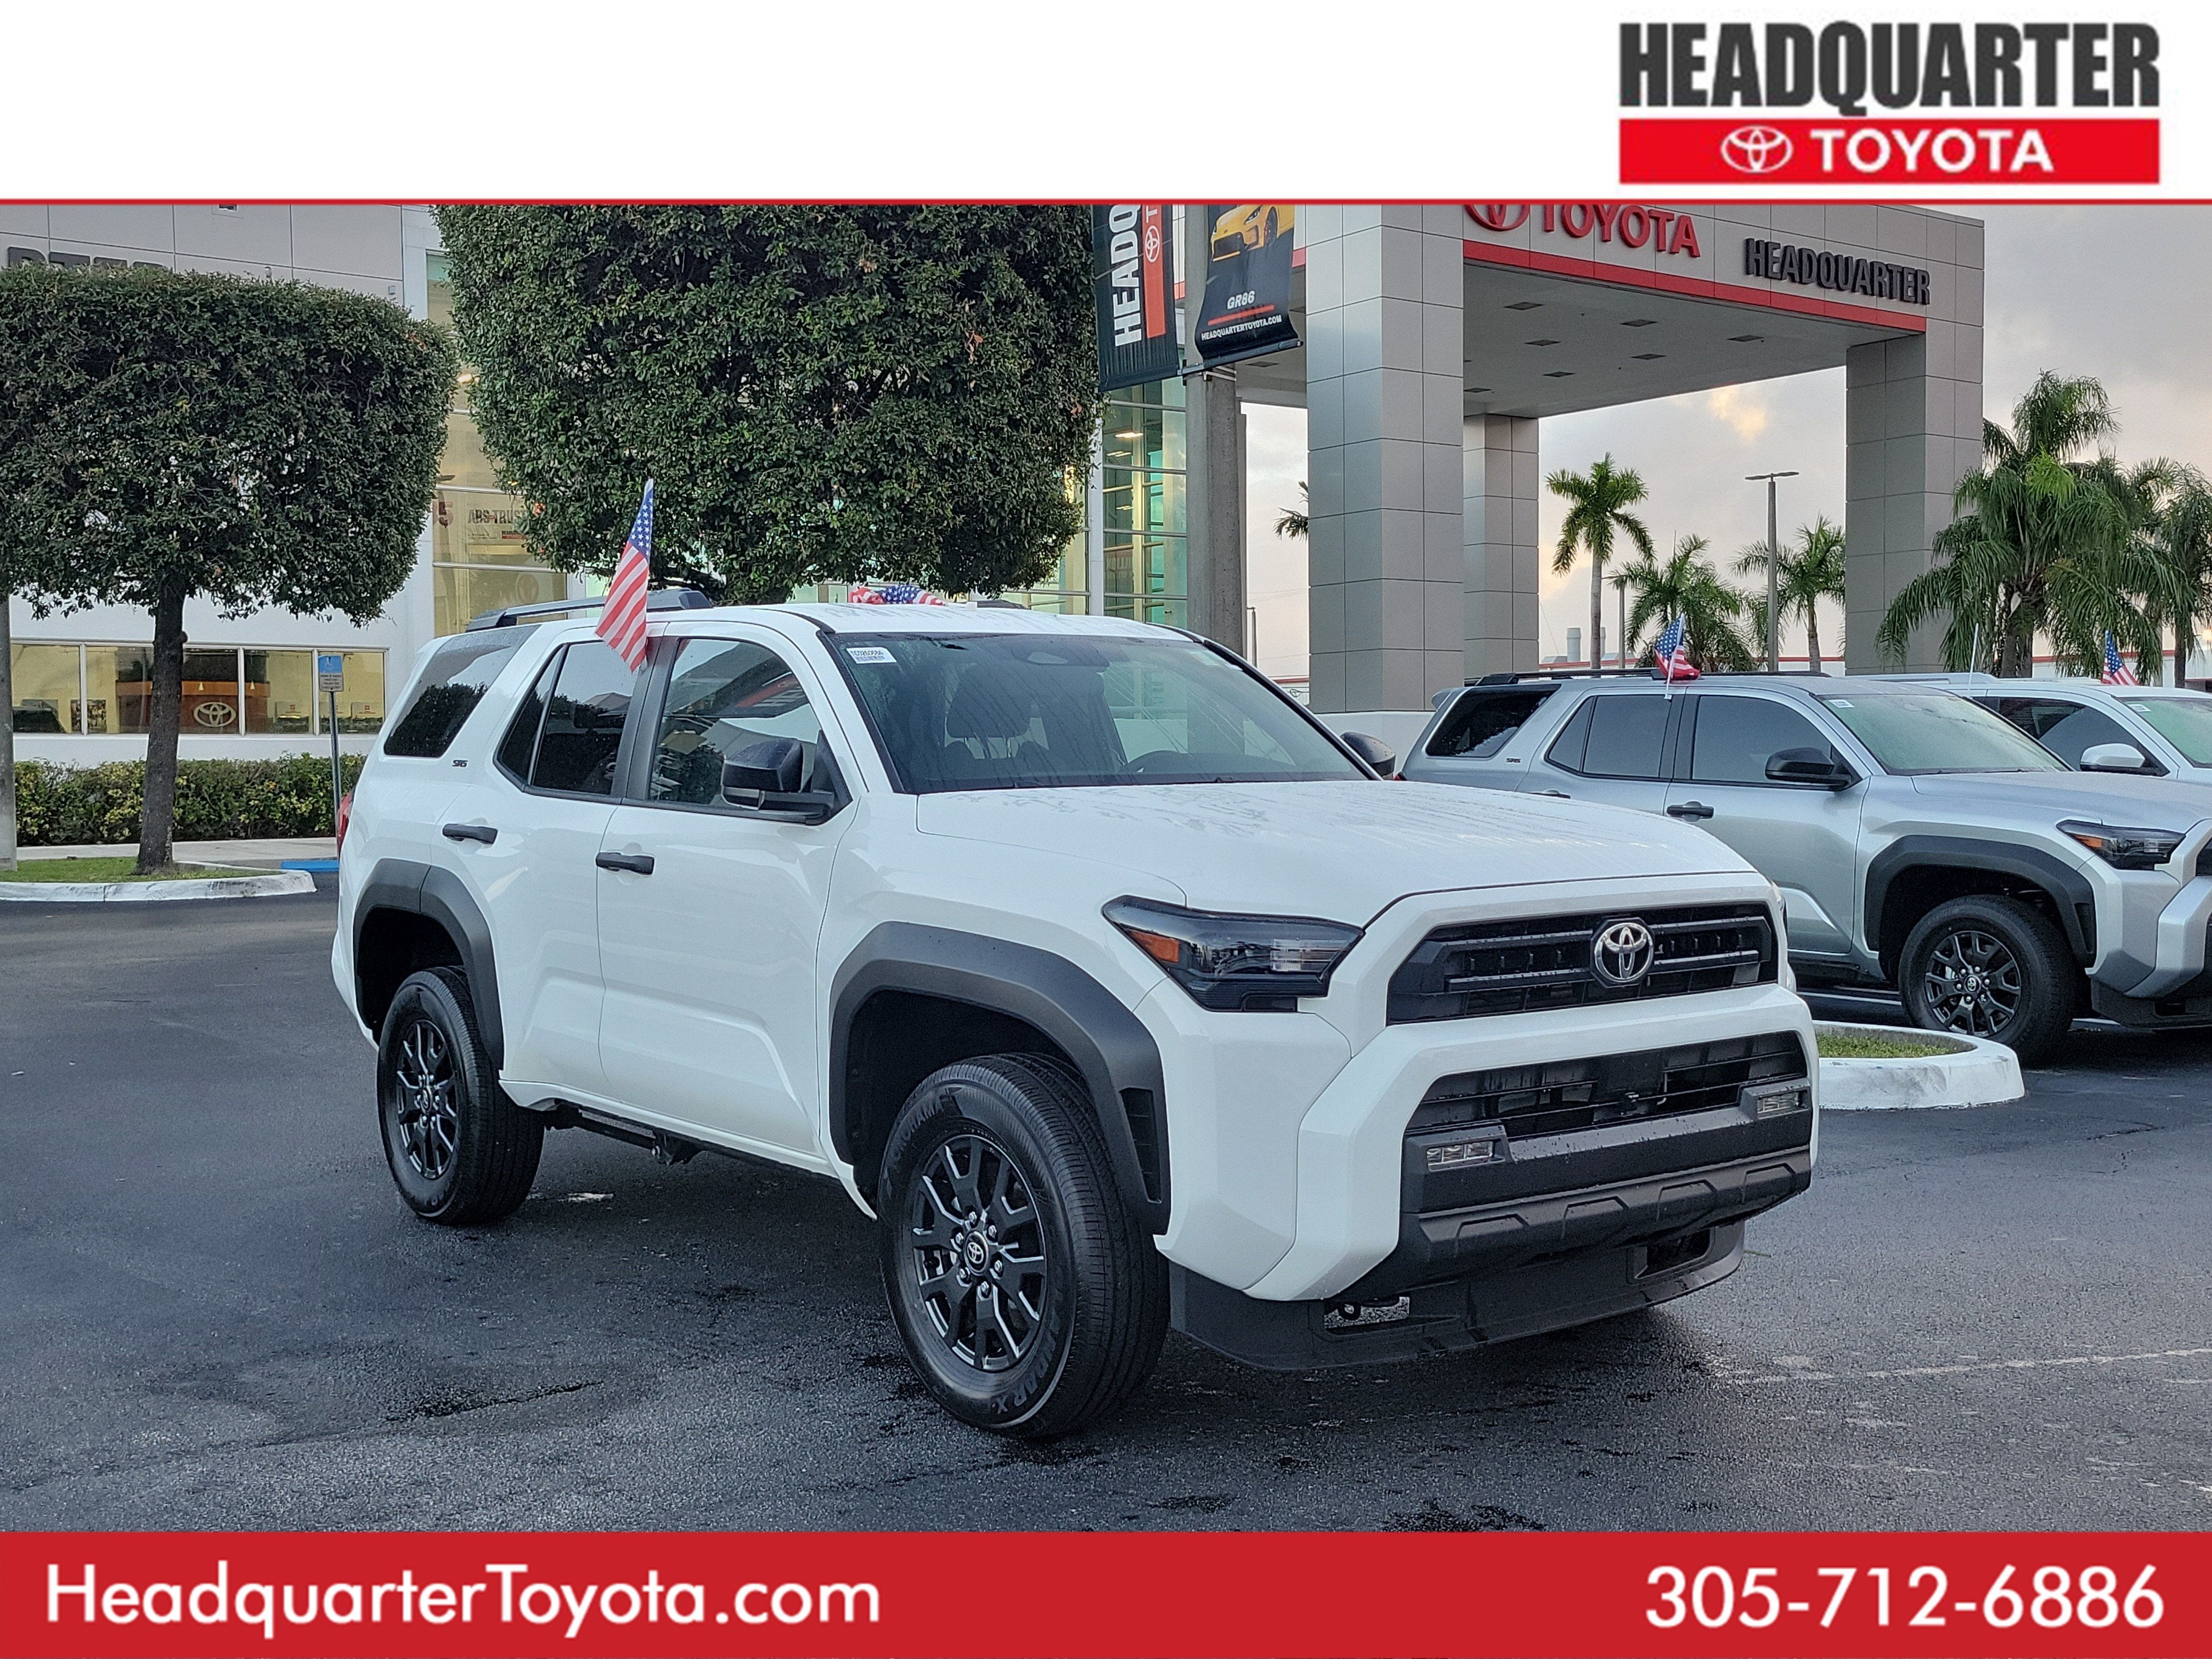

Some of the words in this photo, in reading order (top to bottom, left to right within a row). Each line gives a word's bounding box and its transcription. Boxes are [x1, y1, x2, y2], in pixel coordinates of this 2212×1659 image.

[1745, 238, 1930, 305] HEADQUARTER
[1227, 290, 1255, 309] GR86
[1201, 314, 1282, 341] HEADQUARTERTOYOTA.COM
